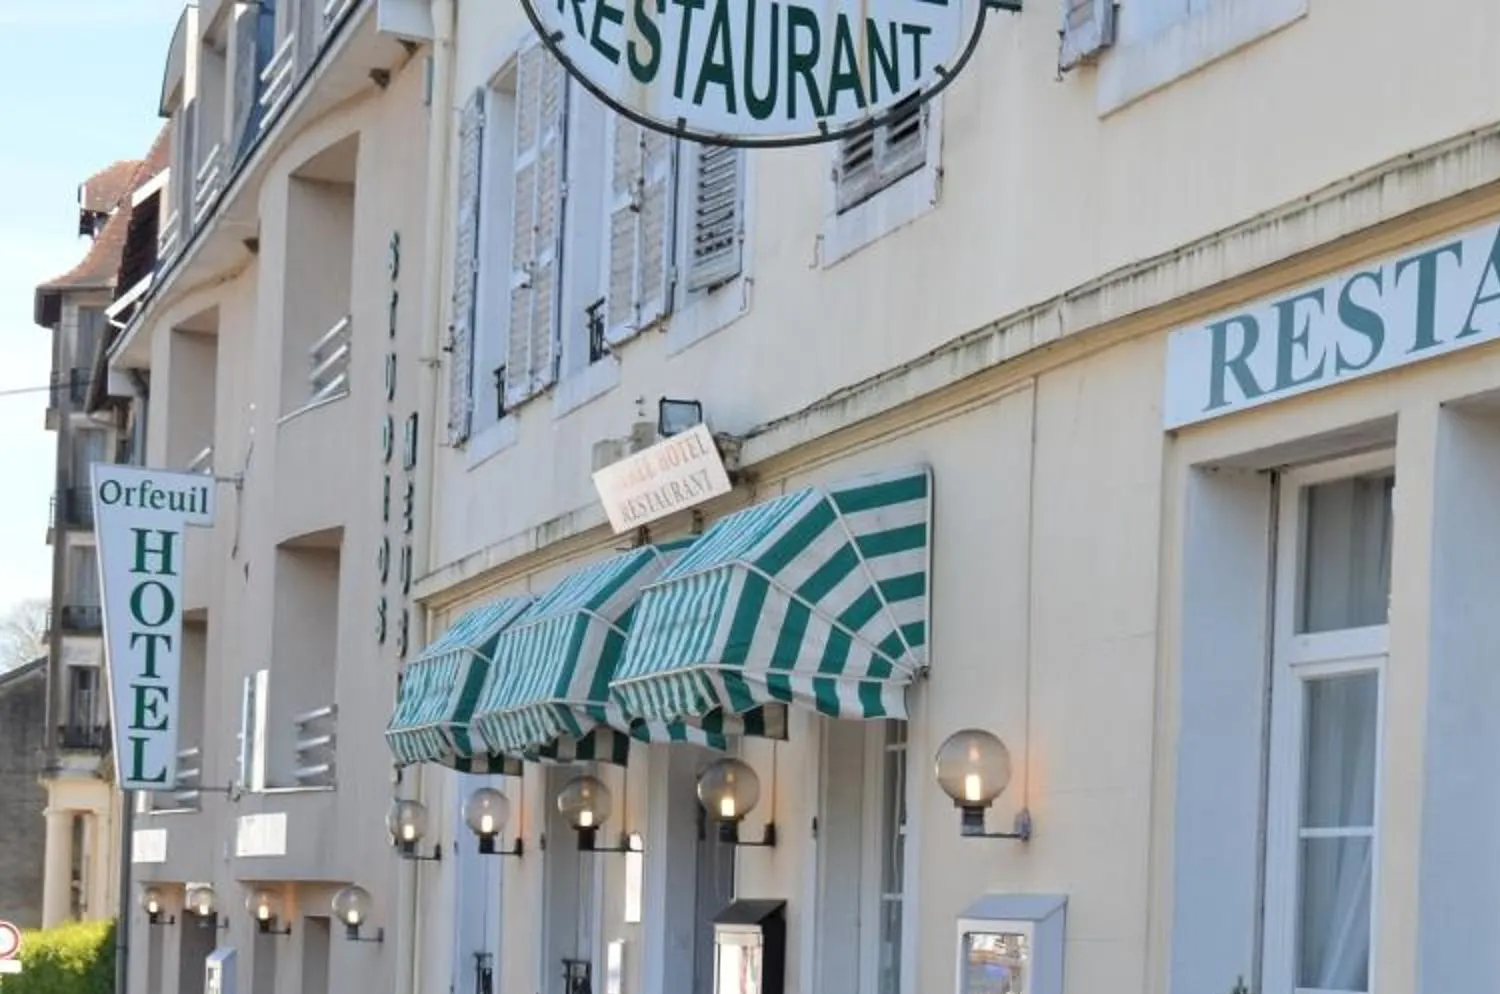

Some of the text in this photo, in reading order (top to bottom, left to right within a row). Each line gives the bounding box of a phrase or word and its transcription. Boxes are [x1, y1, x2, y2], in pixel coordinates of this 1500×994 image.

[99, 479, 209, 515] Orfeuil
[617, 467, 713, 523] RESTAURANT
[127, 527, 180, 784] HOTEL
